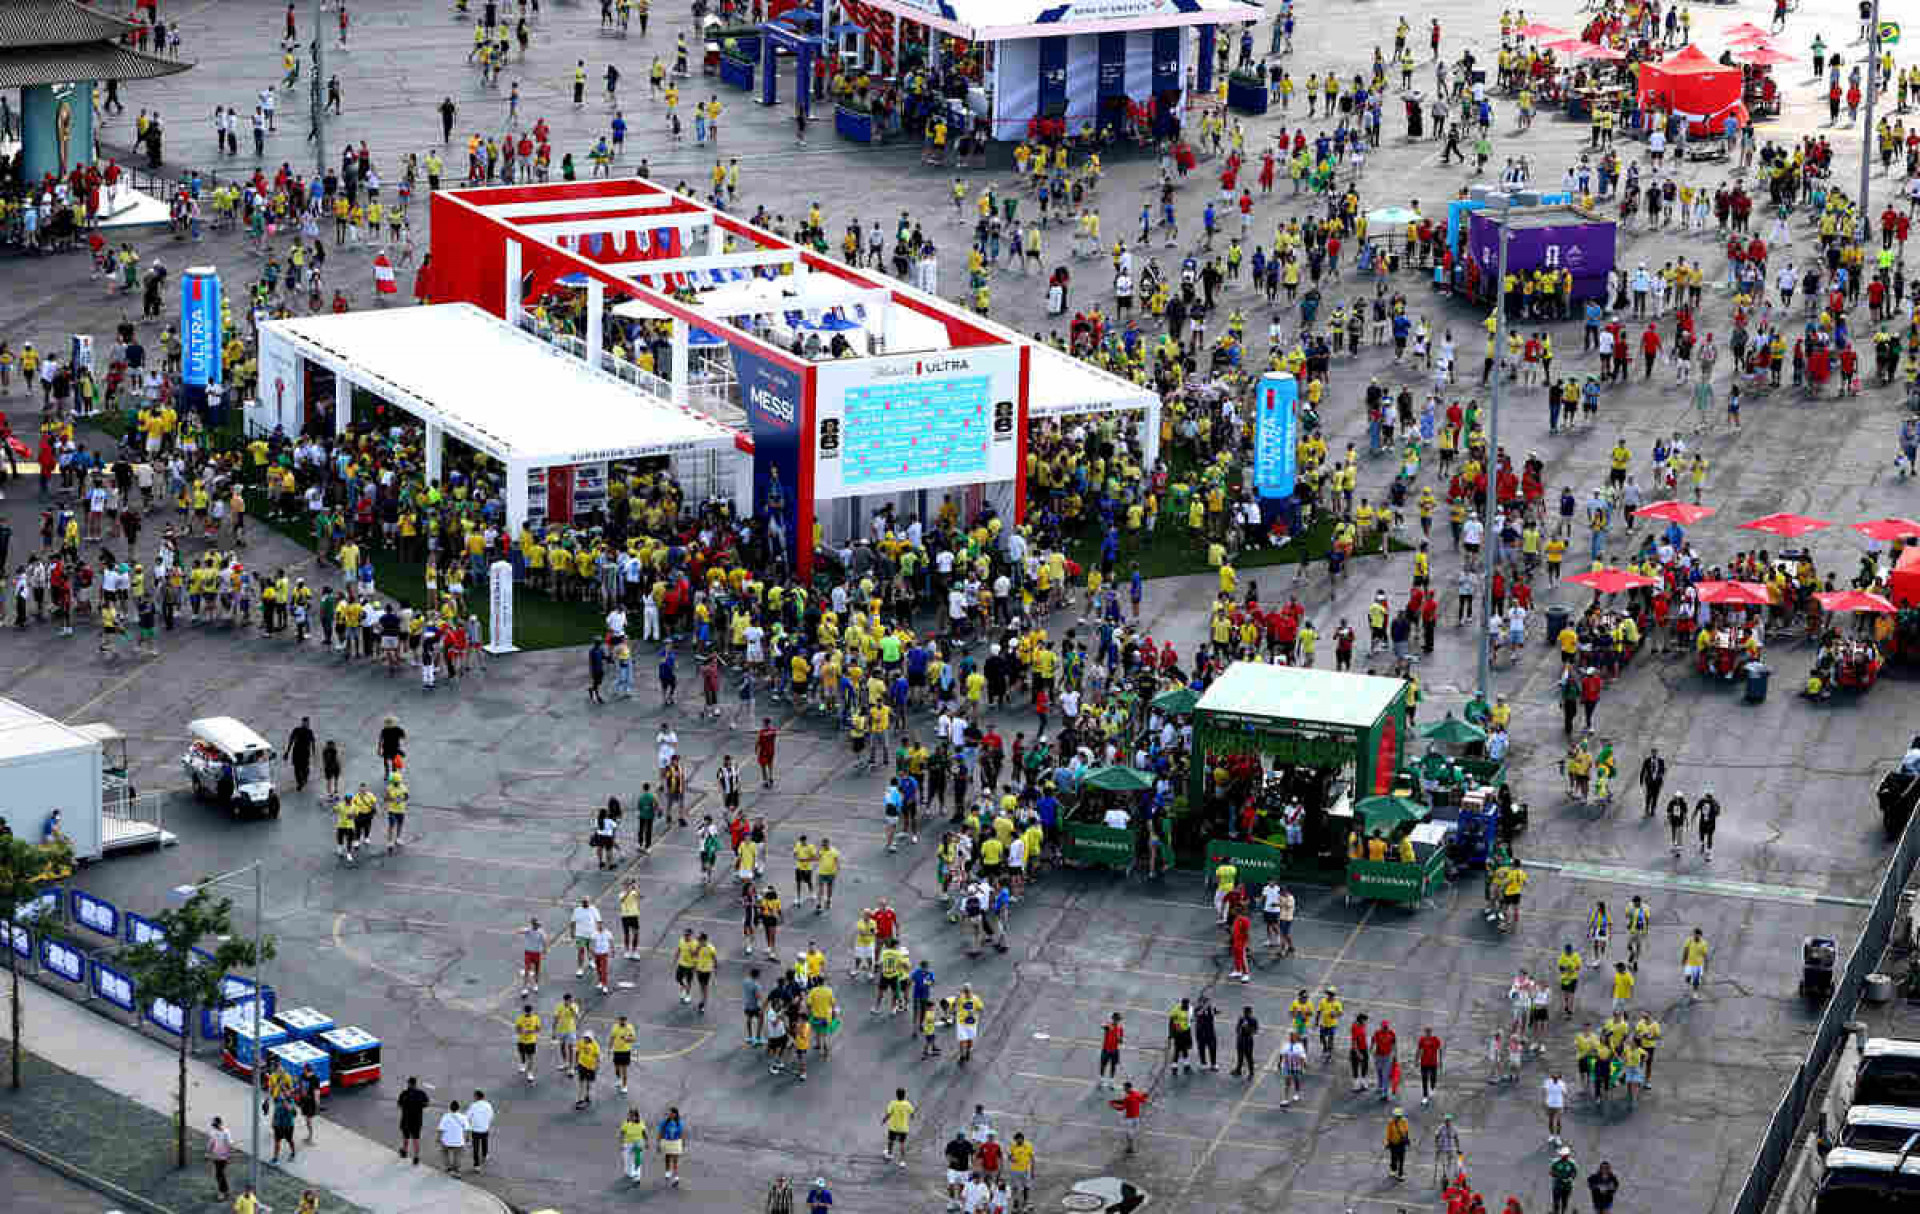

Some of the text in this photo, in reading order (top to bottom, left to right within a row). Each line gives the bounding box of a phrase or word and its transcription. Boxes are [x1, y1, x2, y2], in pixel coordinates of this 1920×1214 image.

[191, 307, 205, 372] ULTRA
[924, 358, 970, 373] ULTRA
[749, 385, 794, 423] MESSI
[571, 448, 625, 461] SUPERIOR
